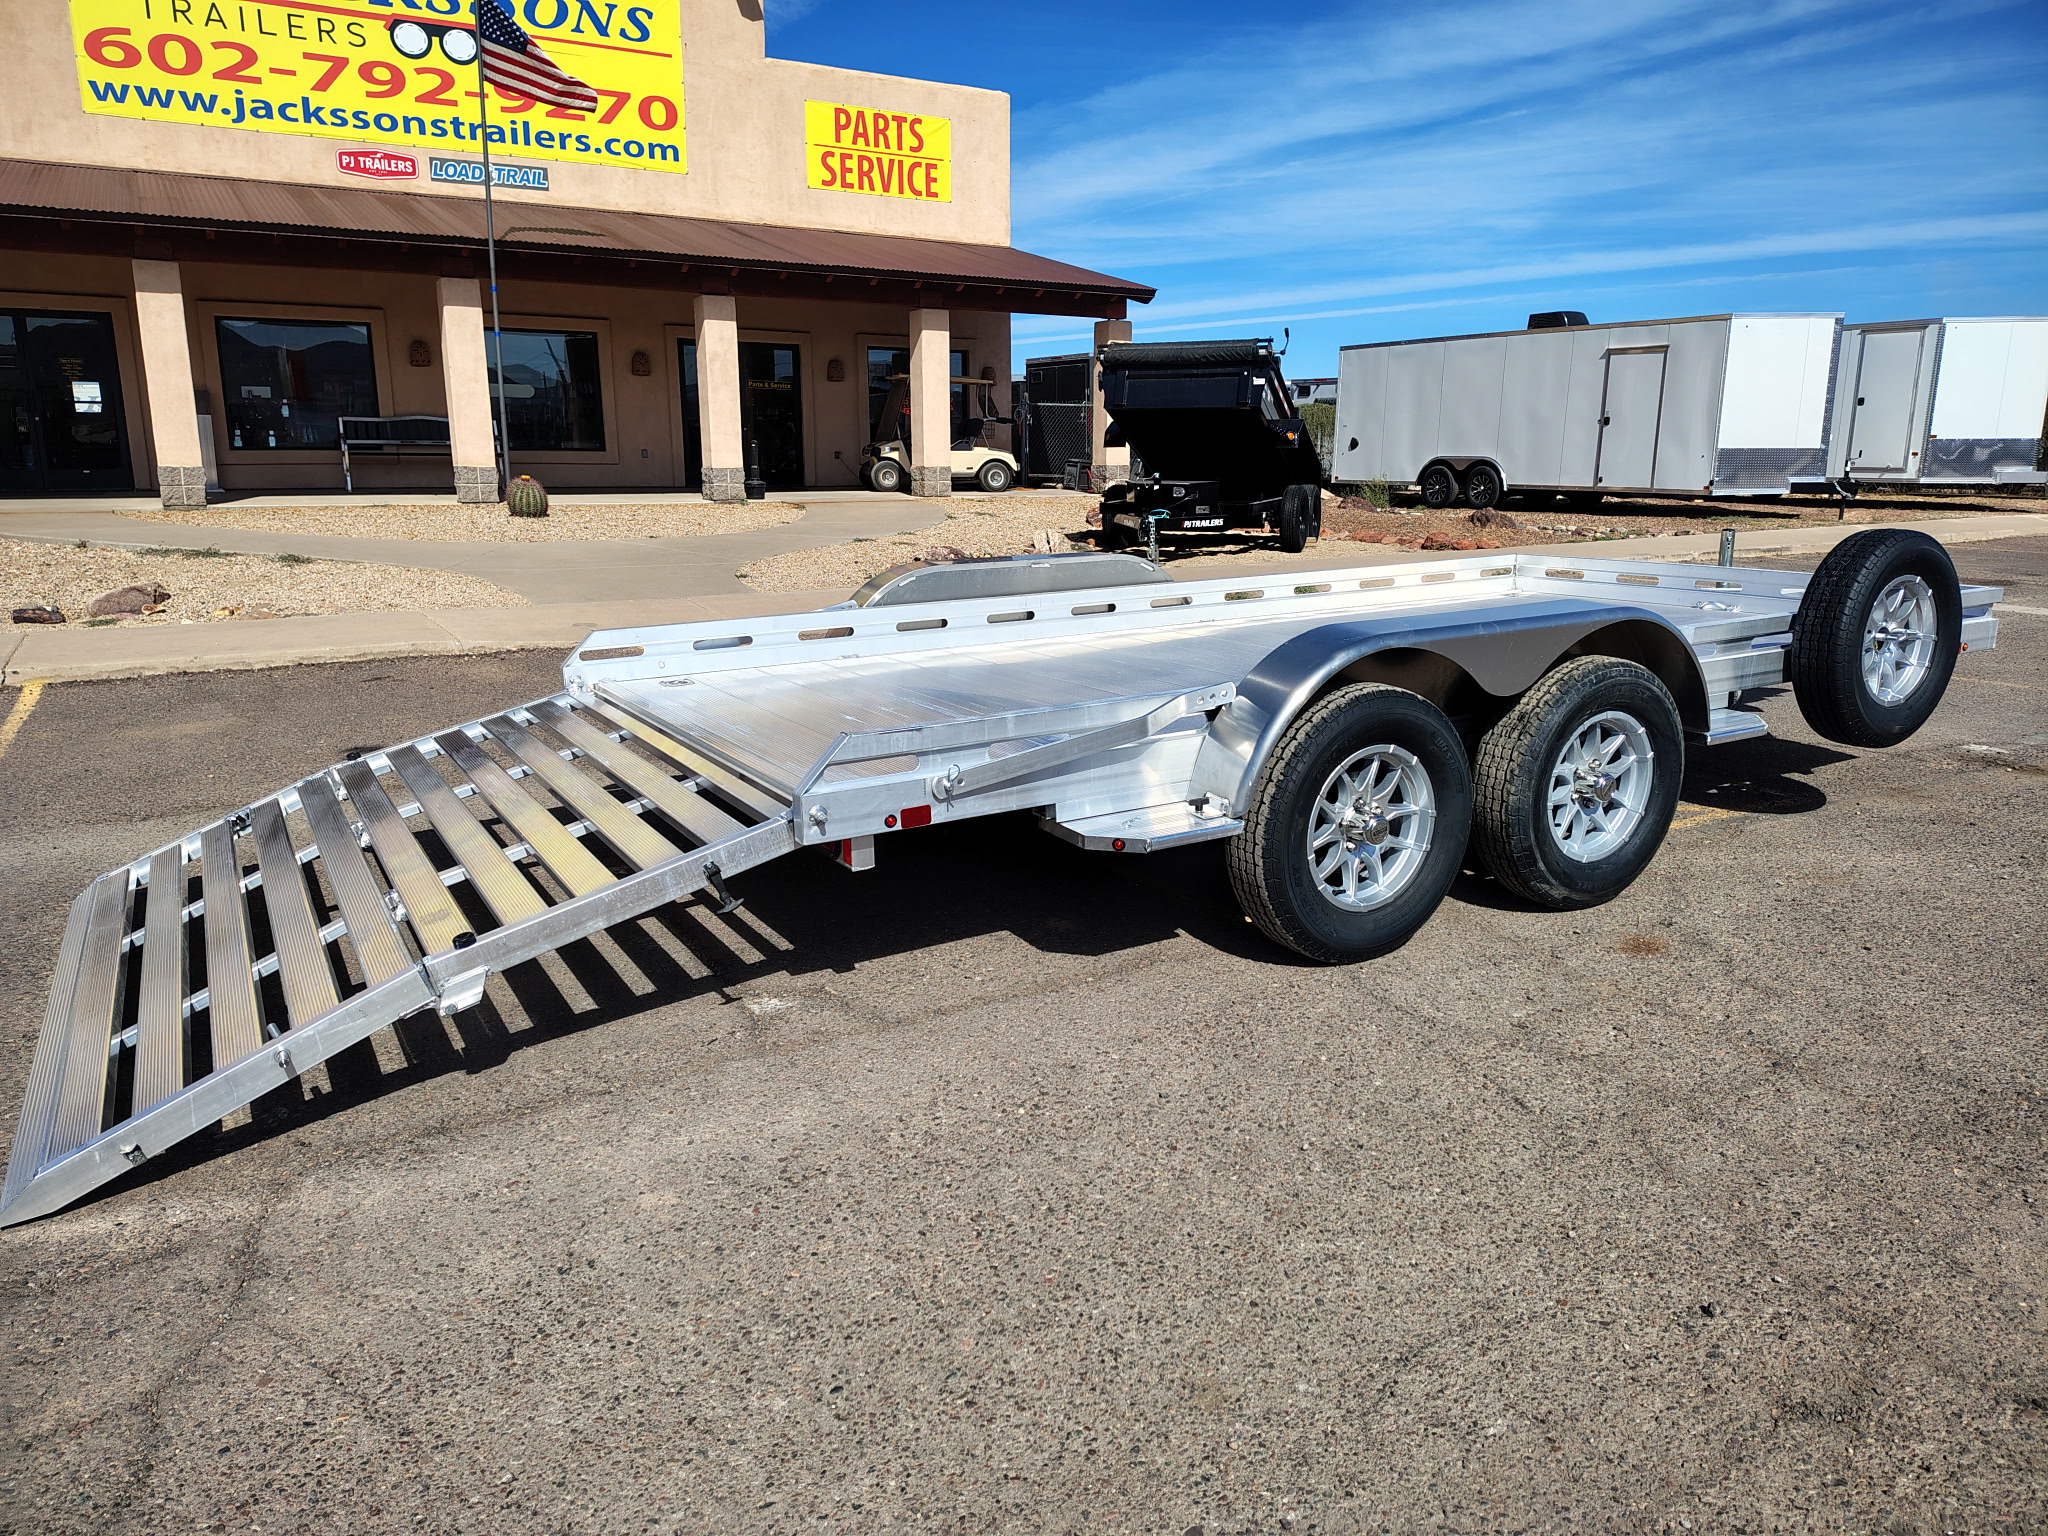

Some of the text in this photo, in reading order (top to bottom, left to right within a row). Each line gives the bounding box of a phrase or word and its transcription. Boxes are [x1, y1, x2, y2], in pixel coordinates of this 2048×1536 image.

[87, 79, 680, 162] www.jackssonstrailers.com
[834, 107, 924, 153] PARTS
[341, 155, 413, 173] PJ TRAILERS
[432, 161, 548, 187] LOAD TRAIL
[821, 150, 939, 198] SERVICE
